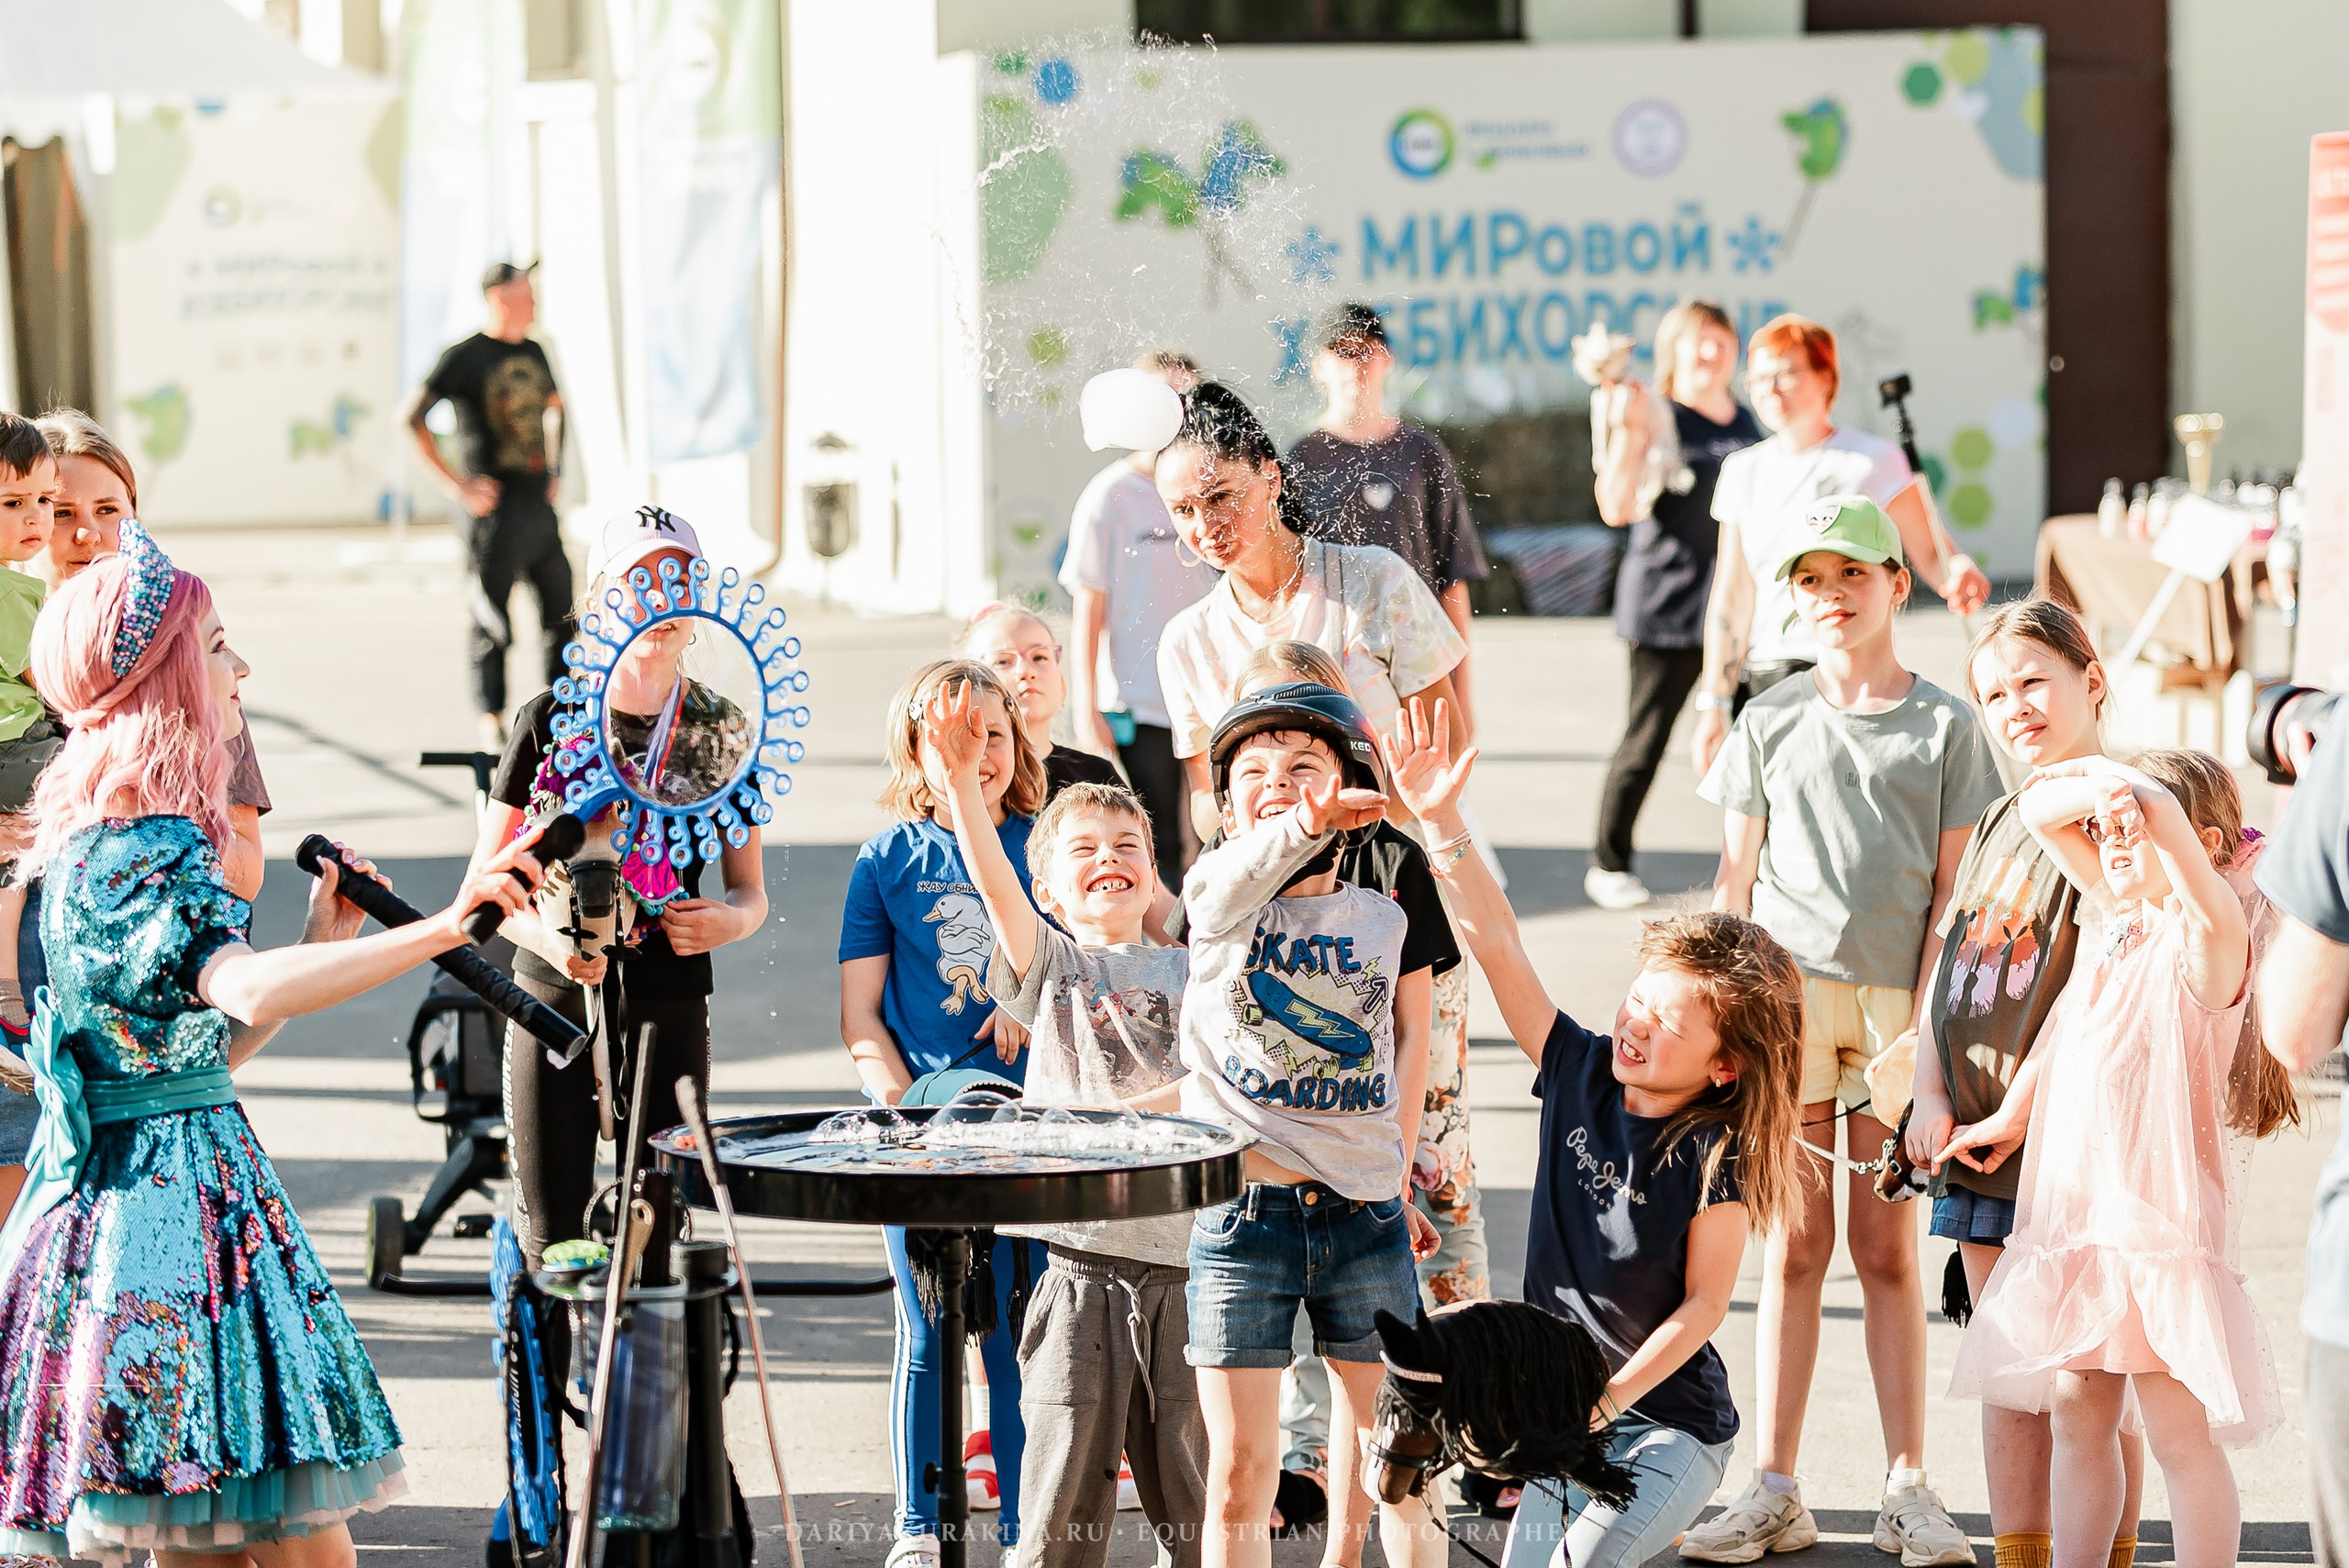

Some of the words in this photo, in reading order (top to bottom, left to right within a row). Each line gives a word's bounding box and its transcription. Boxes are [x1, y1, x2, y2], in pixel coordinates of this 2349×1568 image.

[1350, 740, 1372, 752] KED
[917, 881, 946, 894] ЖДУ
[947, 883, 979, 894] ОБНИ
[1566, 1126, 1598, 1173] Pepe
